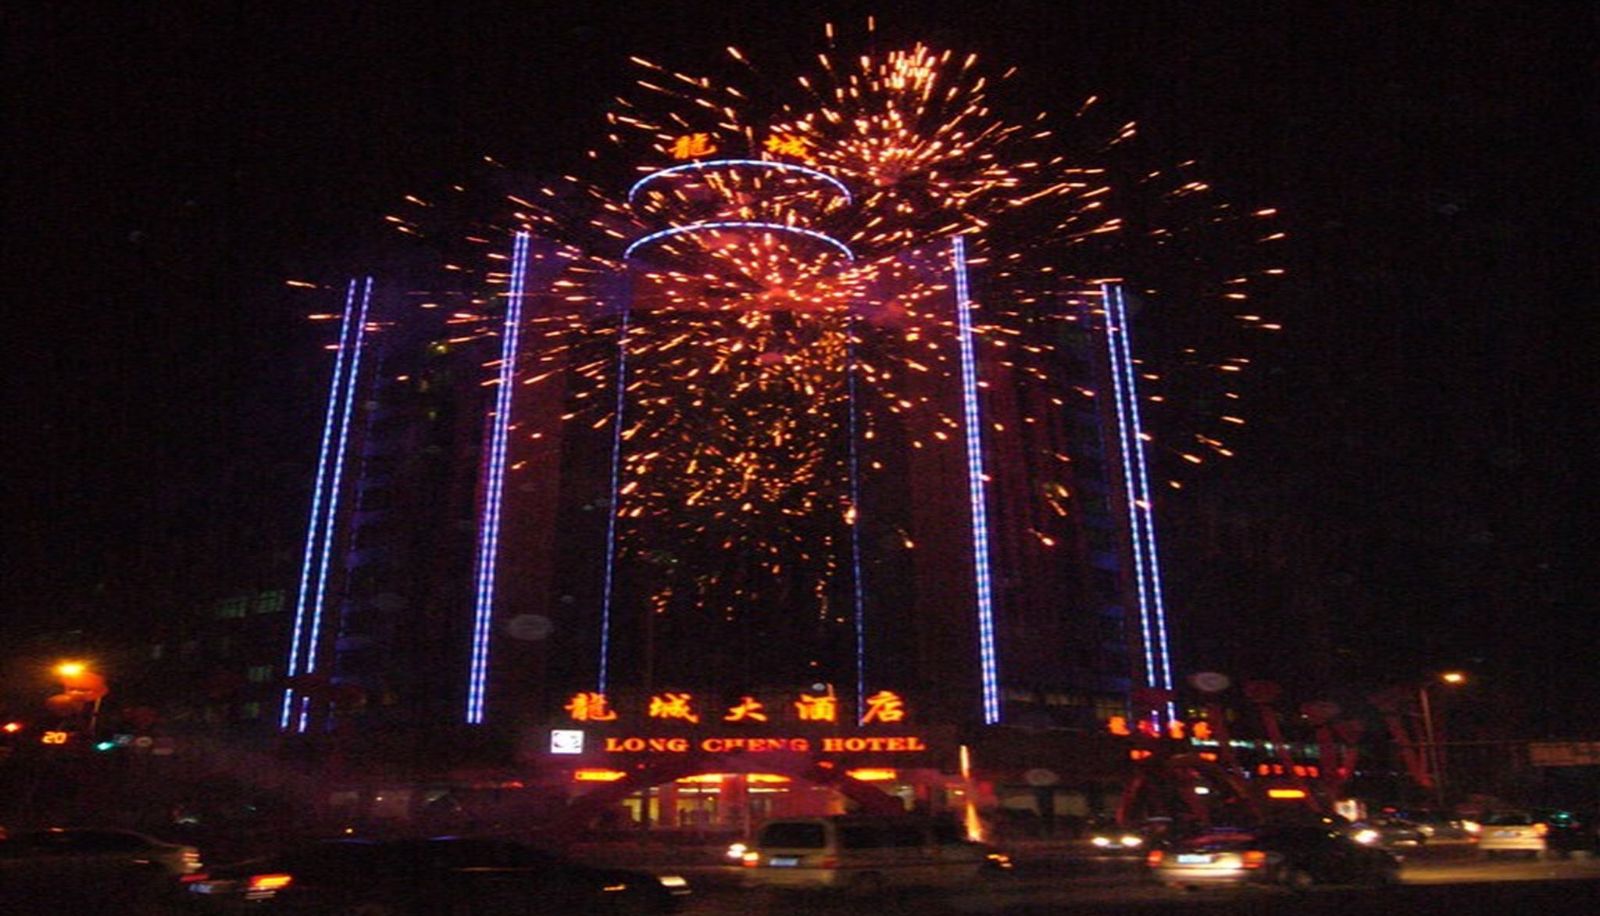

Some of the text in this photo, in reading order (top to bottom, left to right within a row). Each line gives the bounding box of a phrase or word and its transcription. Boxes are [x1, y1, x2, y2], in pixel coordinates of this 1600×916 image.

[566, 691, 904, 722] 龍城大酒店
[41, 731, 68, 744] 20
[605, 736, 925, 752] LONG CHENG HOTEL
